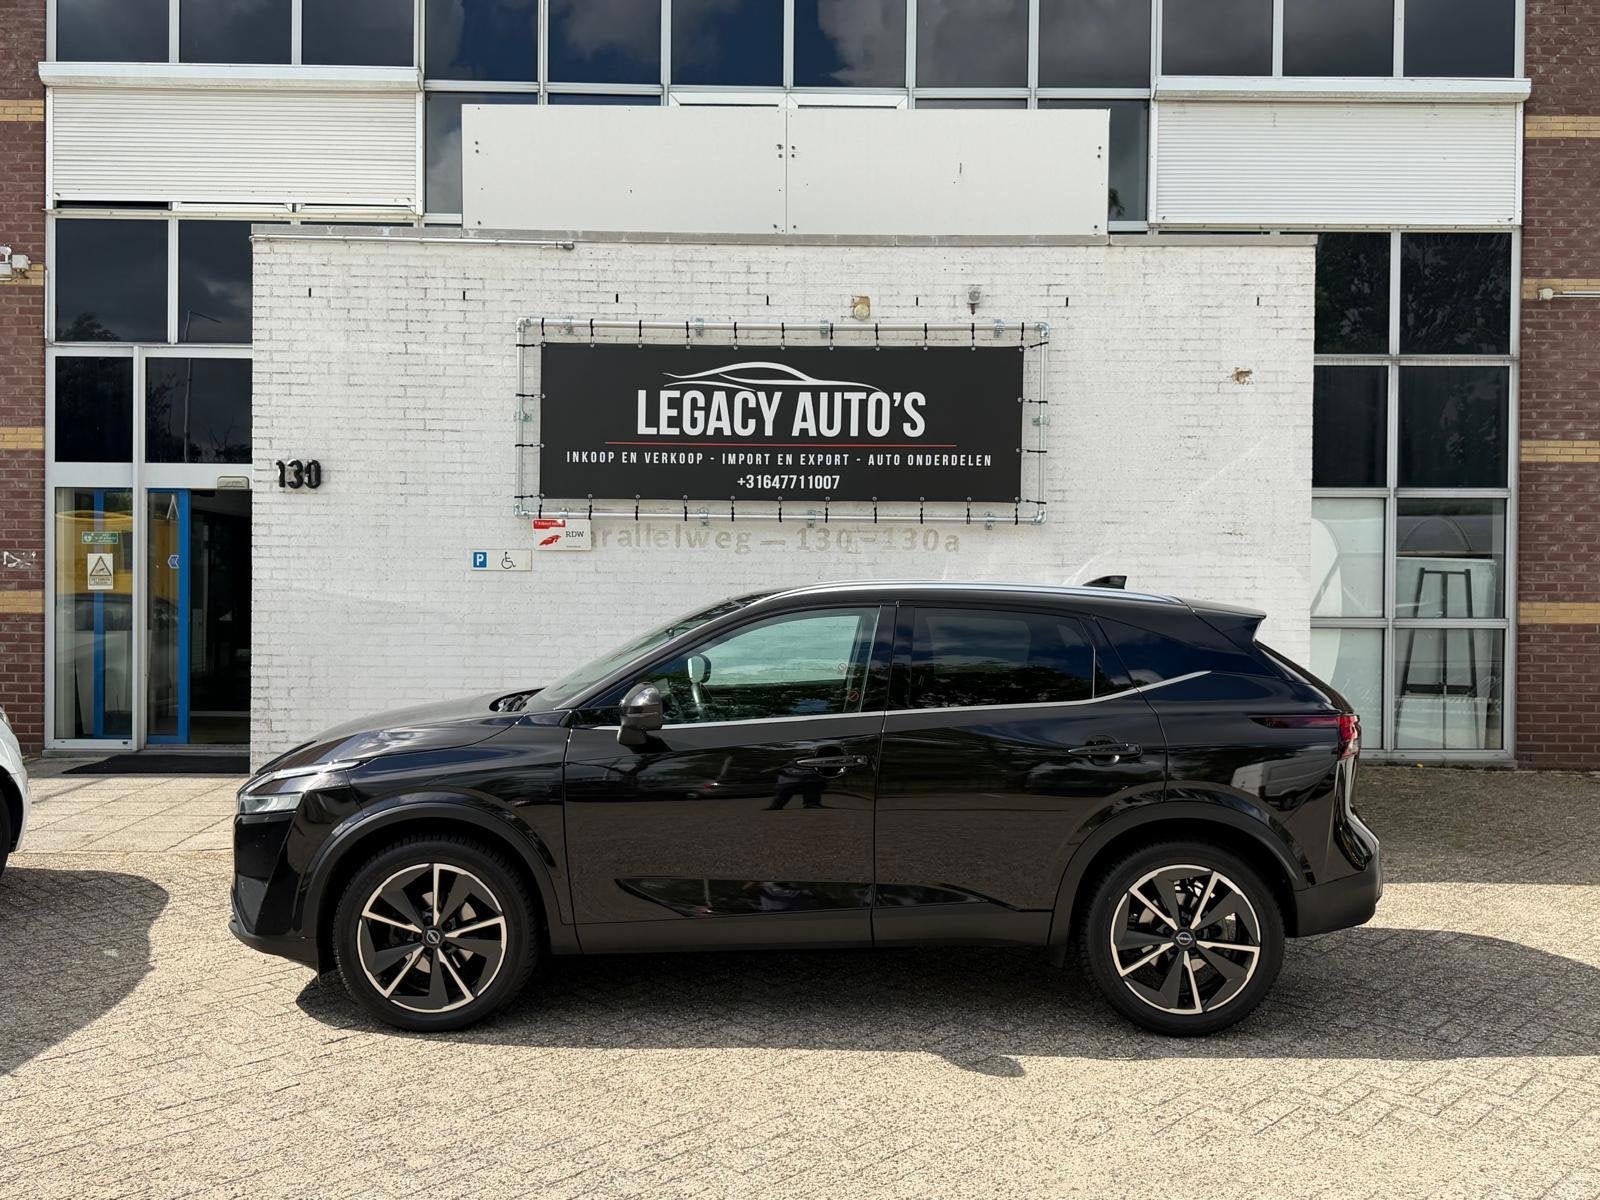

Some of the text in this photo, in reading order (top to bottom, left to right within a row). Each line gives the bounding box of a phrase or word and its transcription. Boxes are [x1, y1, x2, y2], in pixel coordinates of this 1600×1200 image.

[637, 389, 926, 438] LEGACY AUTO'S
[566, 450, 615, 464] INKOOP
[621, 451, 637, 464] EN
[644, 452, 703, 465] VERKOOP
[722, 452, 771, 465] IMPORT
[777, 453, 793, 466] EN
[800, 453, 849, 466] EXPORT
[867, 454, 901, 467] AUTO
[907, 454, 992, 467] ONDERDELEN
[276, 459, 321, 489] 130
[737, 475, 840, 490] +31647711007
[565, 530, 585, 538] RDW
[476, 553, 485, 566] P
